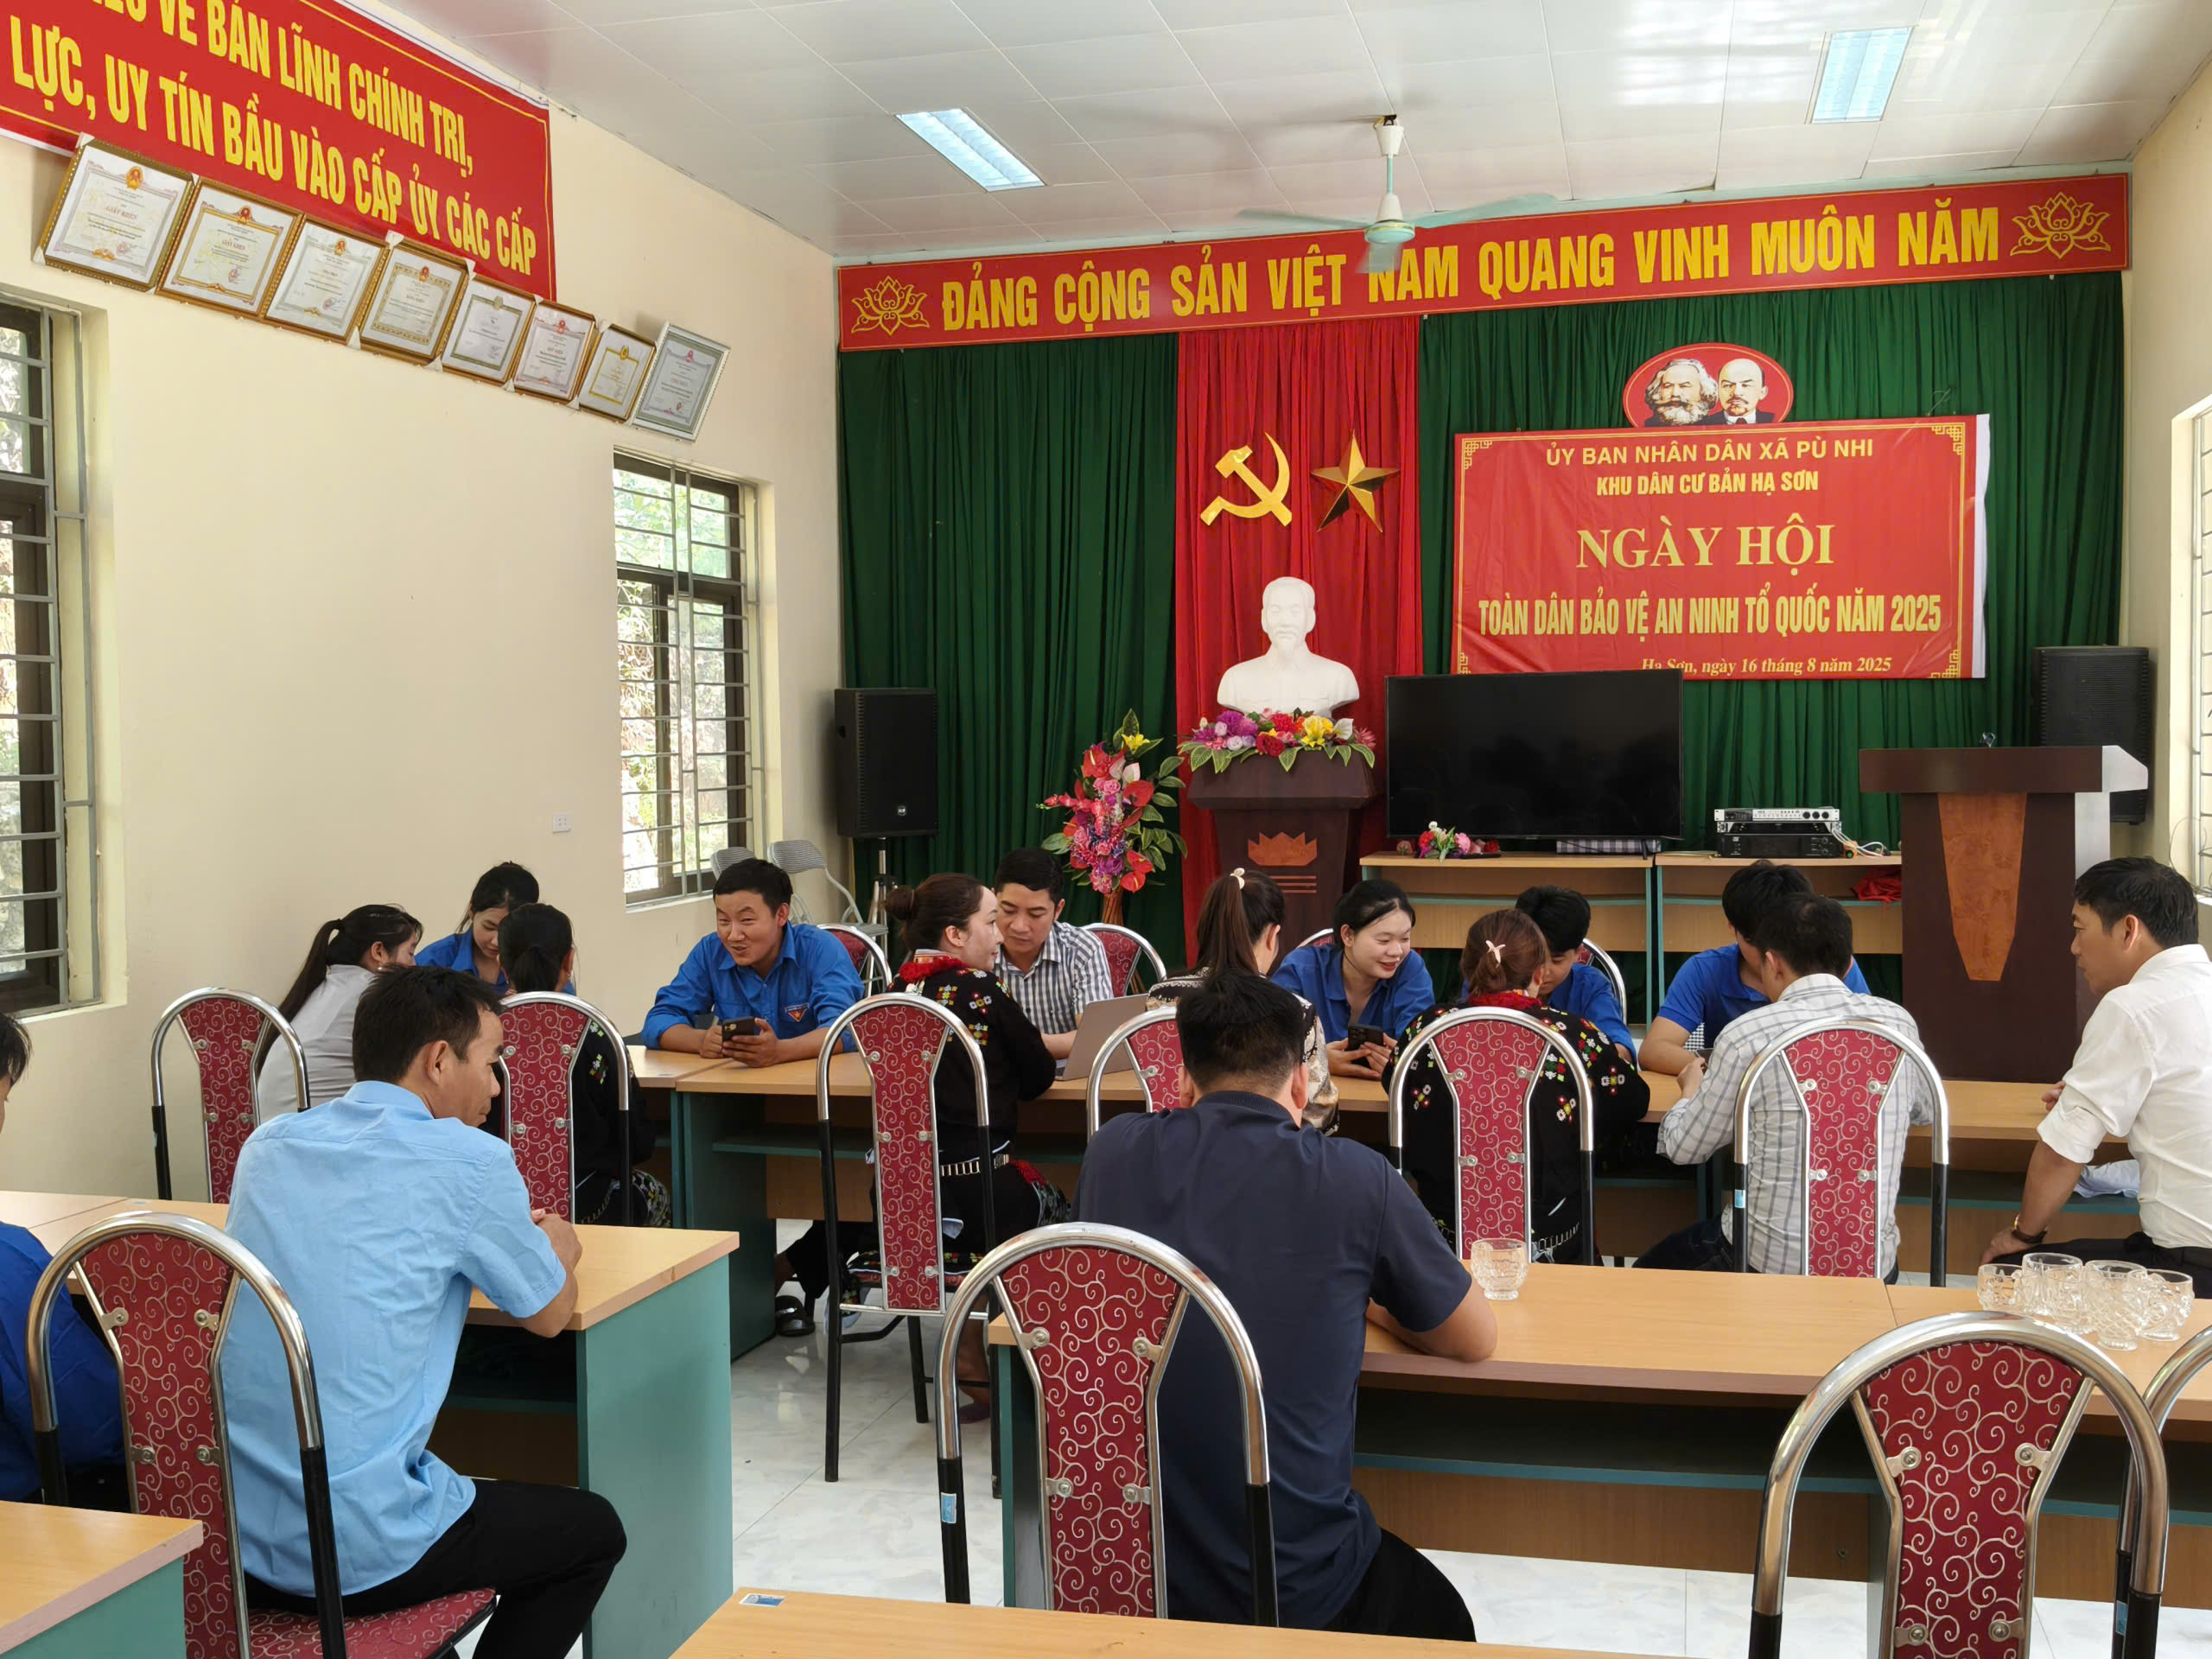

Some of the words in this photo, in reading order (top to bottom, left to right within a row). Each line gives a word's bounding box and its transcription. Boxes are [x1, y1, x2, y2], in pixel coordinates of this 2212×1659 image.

[207, 0, 270, 79] BẢN
[278, 22, 342, 111] LĨNH
[349, 66, 425, 148] CHÍNH
[429, 101, 474, 177] TRỊ,
[10, 16, 96, 121] LỰC,
[105, 54, 149, 131] UY
[159, 71, 215, 156] TÍN
[223, 92, 283, 181] BẦU
[290, 126, 346, 205] VÀO
[353, 147, 403, 225] CẤP
[410, 162, 441, 240] ỦY
[447, 192, 491, 266] CÁC
[496, 206, 537, 276] CẤP
[942, 261, 1038, 331] ĐẢNG
[1055, 261, 1150, 332] CỘNG
[1171, 245, 1247, 317] SẢN
[1268, 245, 1347, 317] VIỆT
[1369, 245, 1459, 303] NAM
[1479, 234, 1615, 301] QUANG
[1634, 225, 1730, 283] VINH
[1751, 204, 1875, 276] MUÔN
[1898, 198, 1999, 267] NĂM
[1547, 442, 1575, 467] ỦY
[1583, 447, 1628, 465] BAN
[1636, 440, 1698, 464] NHÂN
[1706, 438, 1752, 462] DÂN
[1759, 436, 1790, 461] XÃ
[1797, 435, 1827, 460] PÙ
[1834, 439, 1873, 458] NHI
[1597, 476, 1632, 497] KHU
[1637, 471, 1675, 495] DÂN
[1680, 471, 1707, 494] CƯ
[1709, 466, 1746, 493] BẢN
[1751, 471, 1777, 497] HẠ
[1781, 469, 1819, 492] SƠN
[1575, 515, 1723, 569] NGÀY
[1736, 512, 1836, 576] HỘI
[1478, 592, 1529, 636] TOÀN
[1535, 591, 1574, 635] DÂN
[1580, 586, 1620, 635] BẢO
[1625, 590, 1649, 643] VỆ
[1655, 597, 1684, 634] AN
[1689, 597, 1739, 634] NINH
[1745, 581, 1771, 634] TỔ
[1776, 582, 1831, 639] QUỐC
[1837, 587, 1885, 633] NĂM
[1891, 594, 1942, 632] 2025
[1701, 658, 1737, 677] ngày
[1741, 658, 1758, 672] 16
[1762, 657, 1804, 677] tháng
[1807, 657, 1817, 672] 8
[1820, 657, 1853, 672] năm
[1857, 657, 1892, 672] 2025
